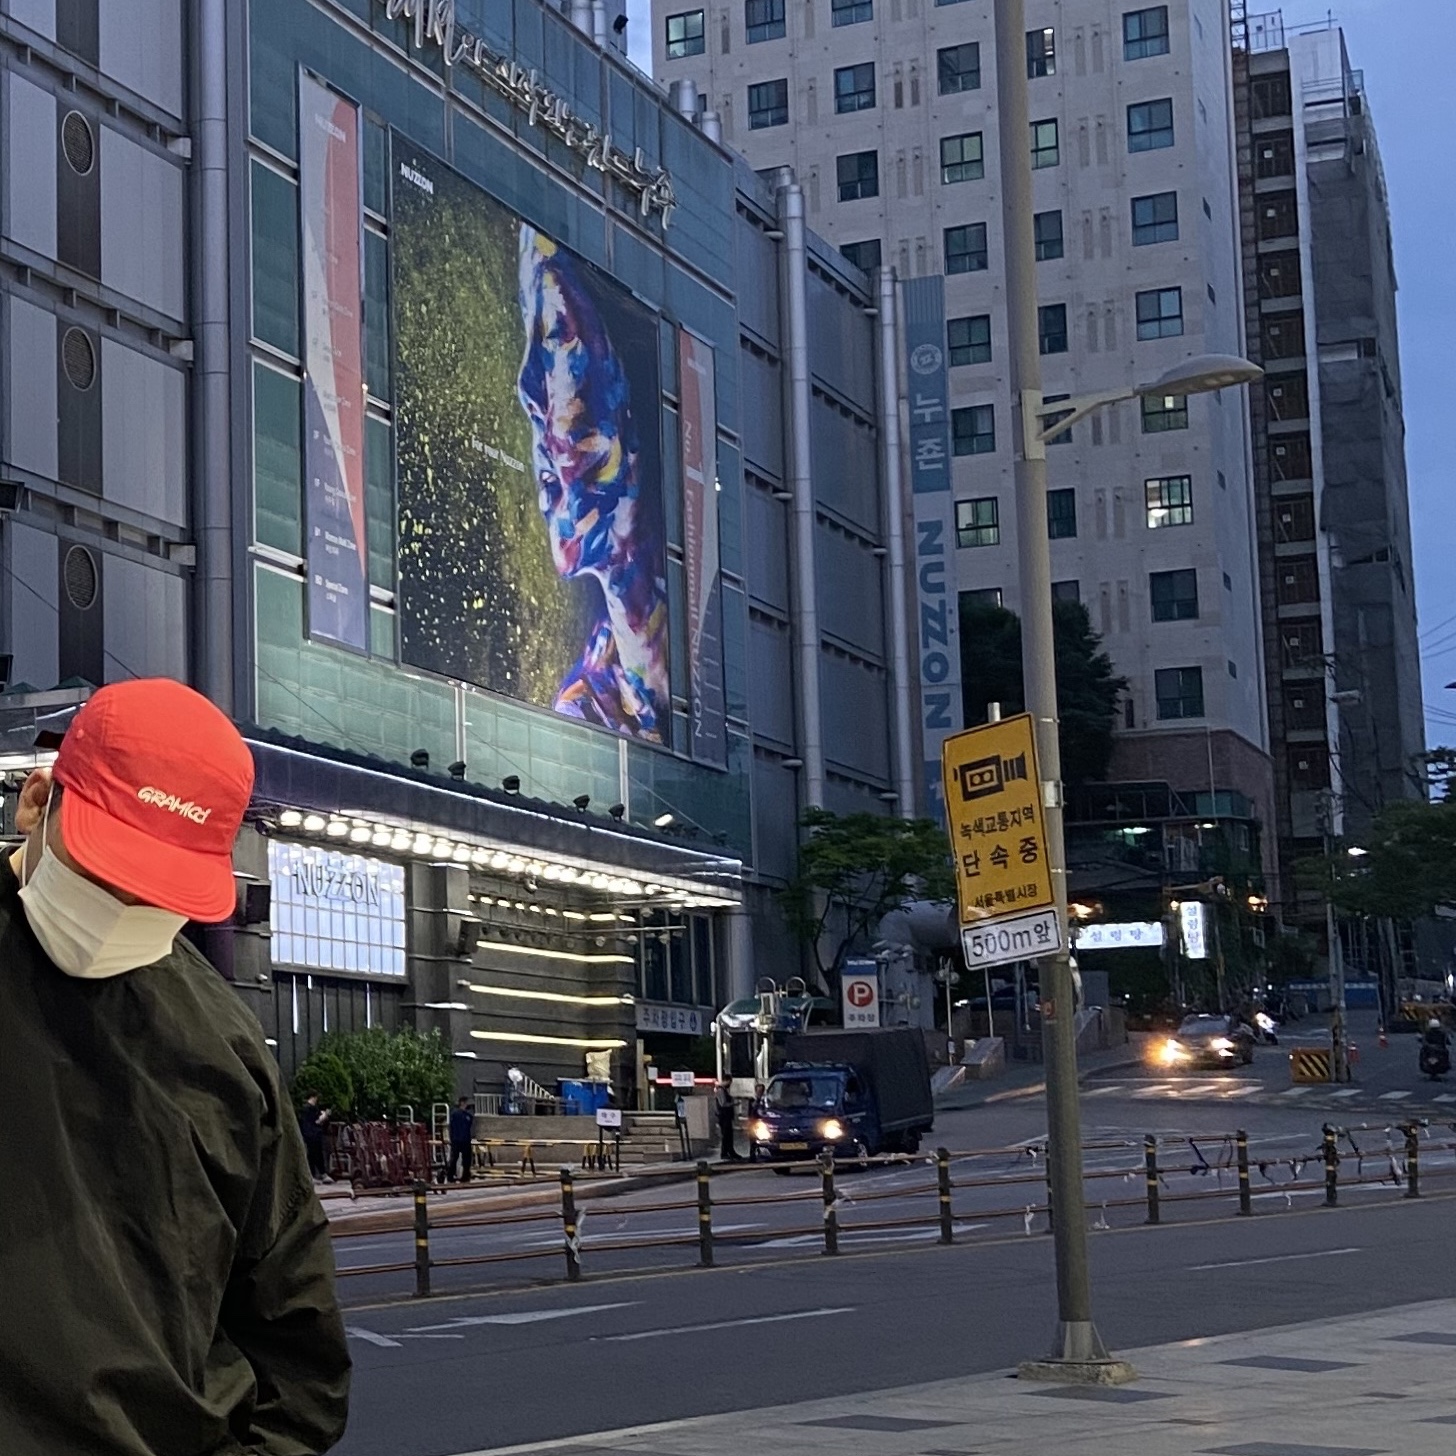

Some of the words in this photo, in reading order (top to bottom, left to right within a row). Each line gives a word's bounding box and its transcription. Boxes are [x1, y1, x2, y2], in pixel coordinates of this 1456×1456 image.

[917, 519, 952, 729] NUZZON
[960, 803, 1035, 840] 녹색교통지역
[295, 861, 380, 907] NUZZON
[974, 883, 1038, 909] 서울특별시장
